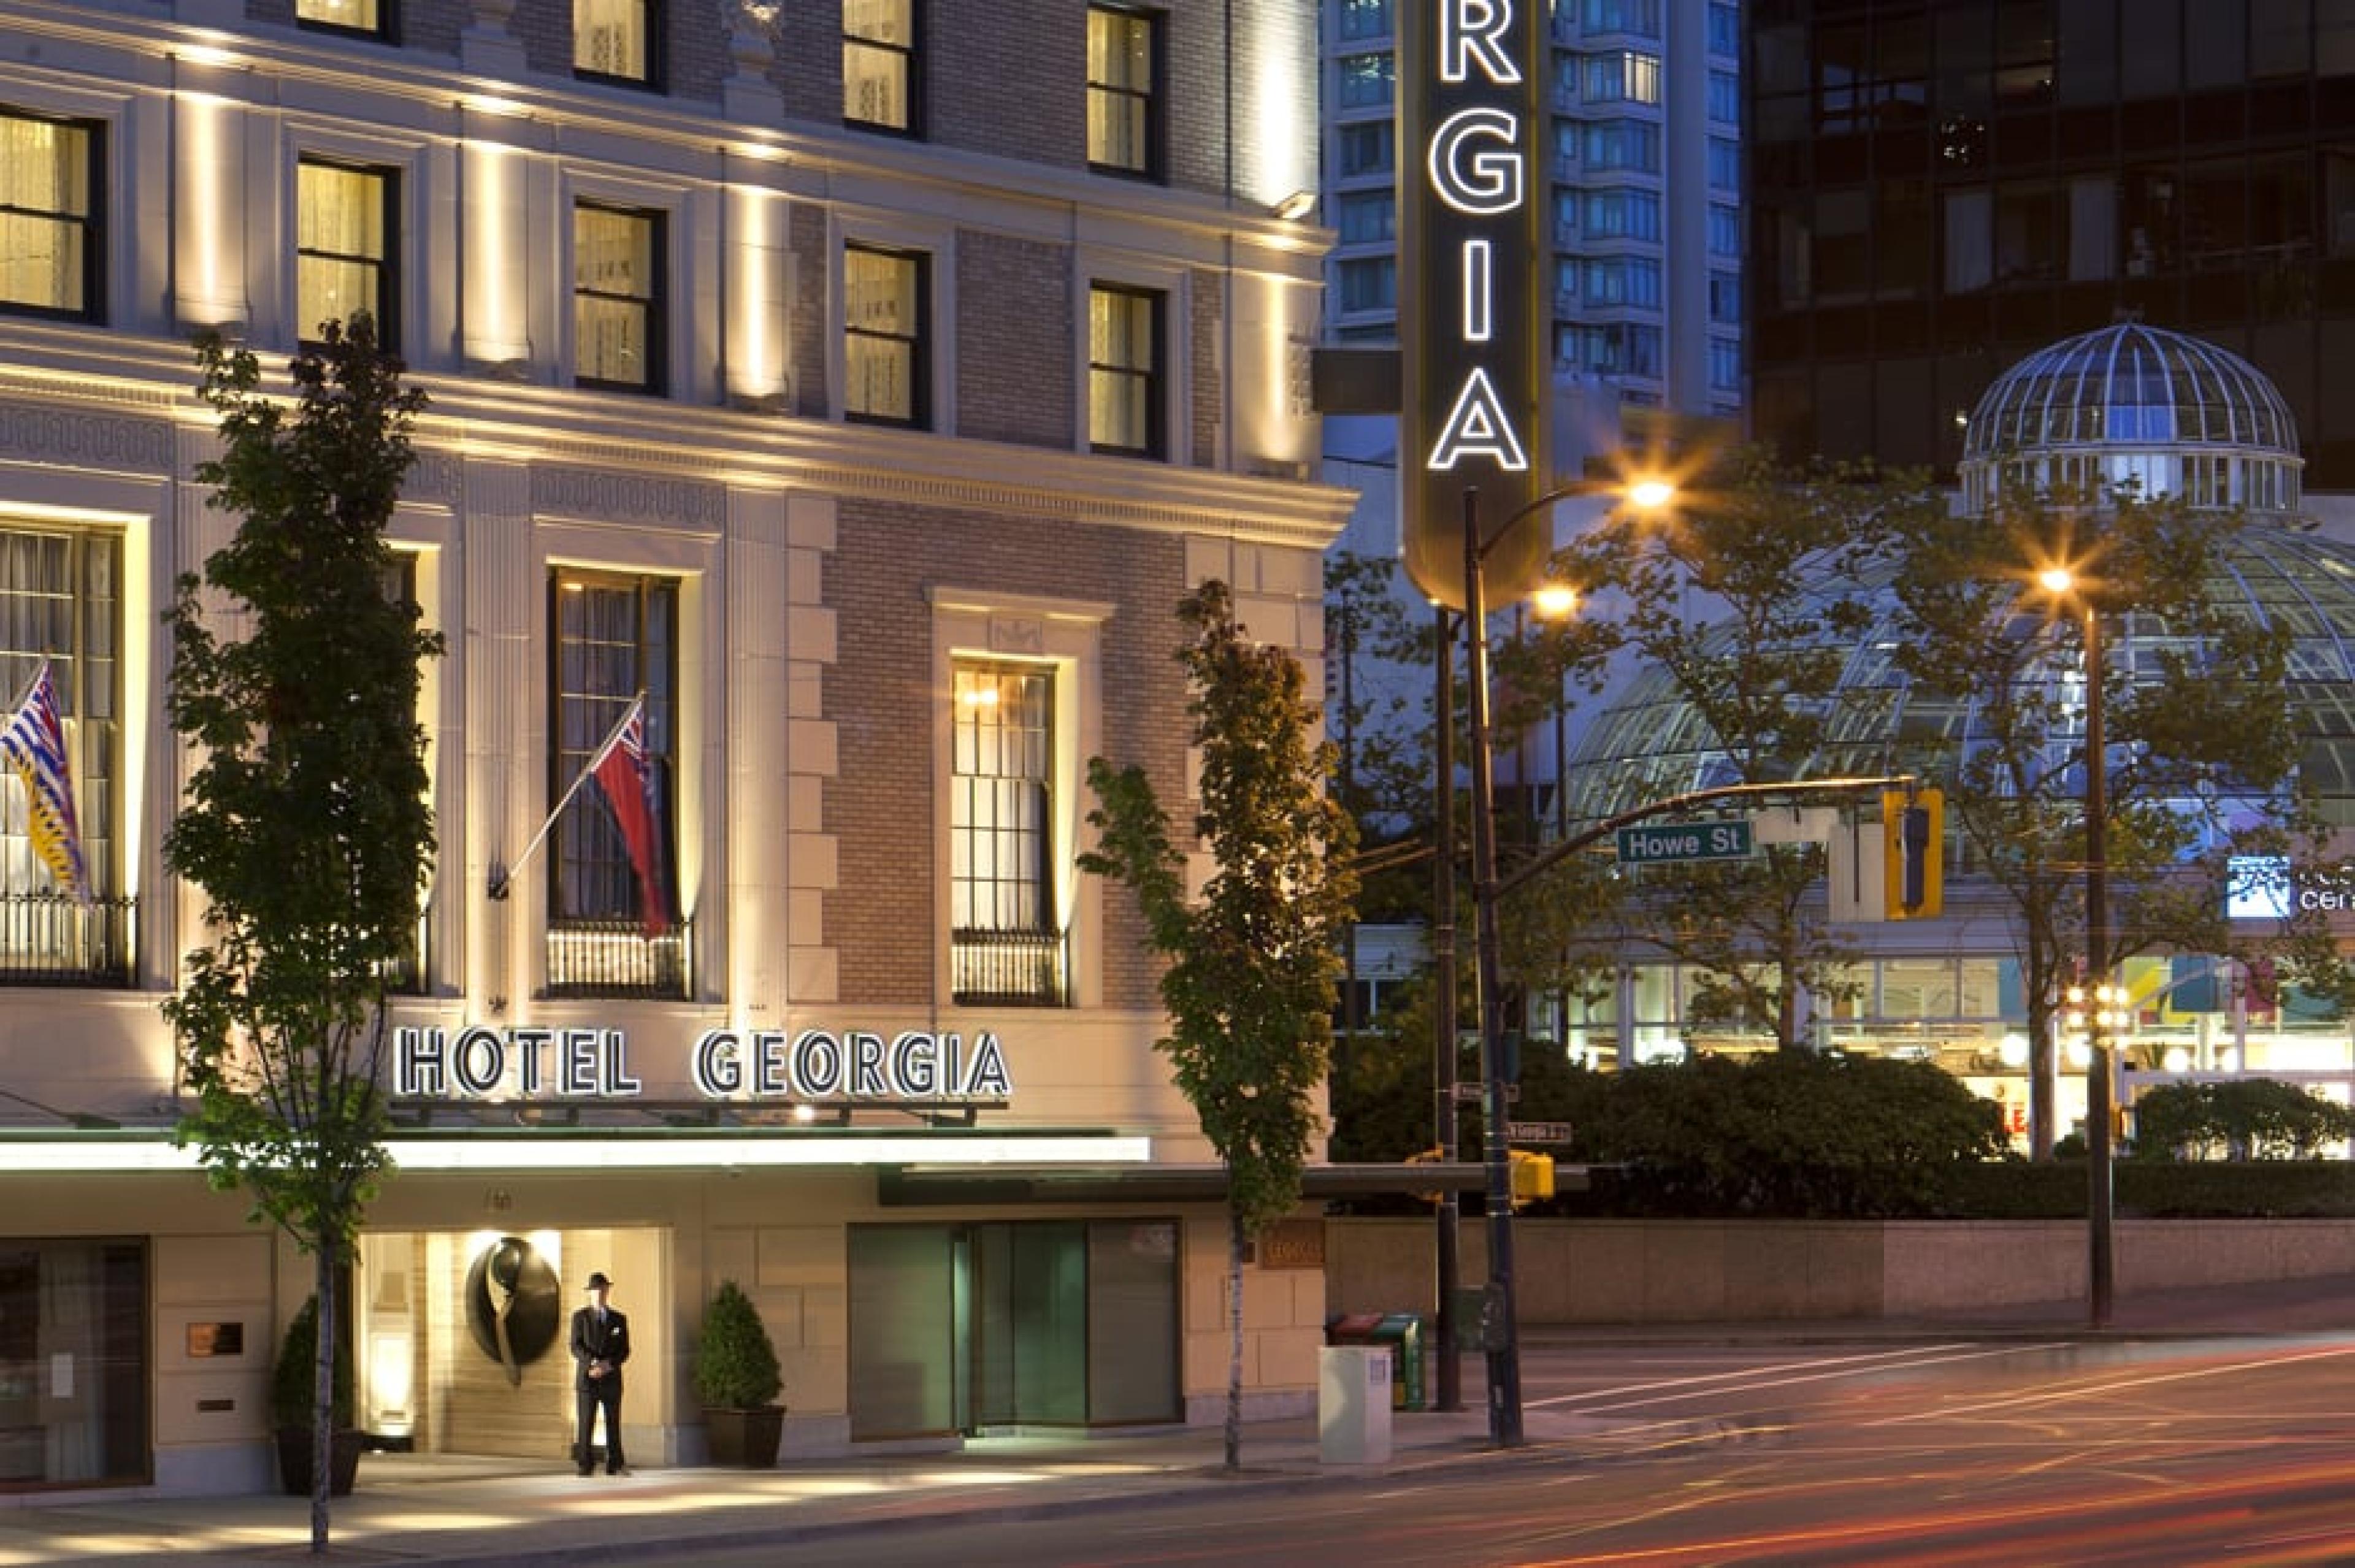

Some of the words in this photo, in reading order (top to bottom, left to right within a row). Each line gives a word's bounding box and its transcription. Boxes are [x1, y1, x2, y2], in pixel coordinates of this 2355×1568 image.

[1427, 0, 1528, 471] RGIA
[1629, 833, 1701, 857] Howe
[1710, 827, 1741, 853] St
[392, 1025, 641, 1096] HOTEL
[692, 1030, 1012, 1098] GEORGIA
